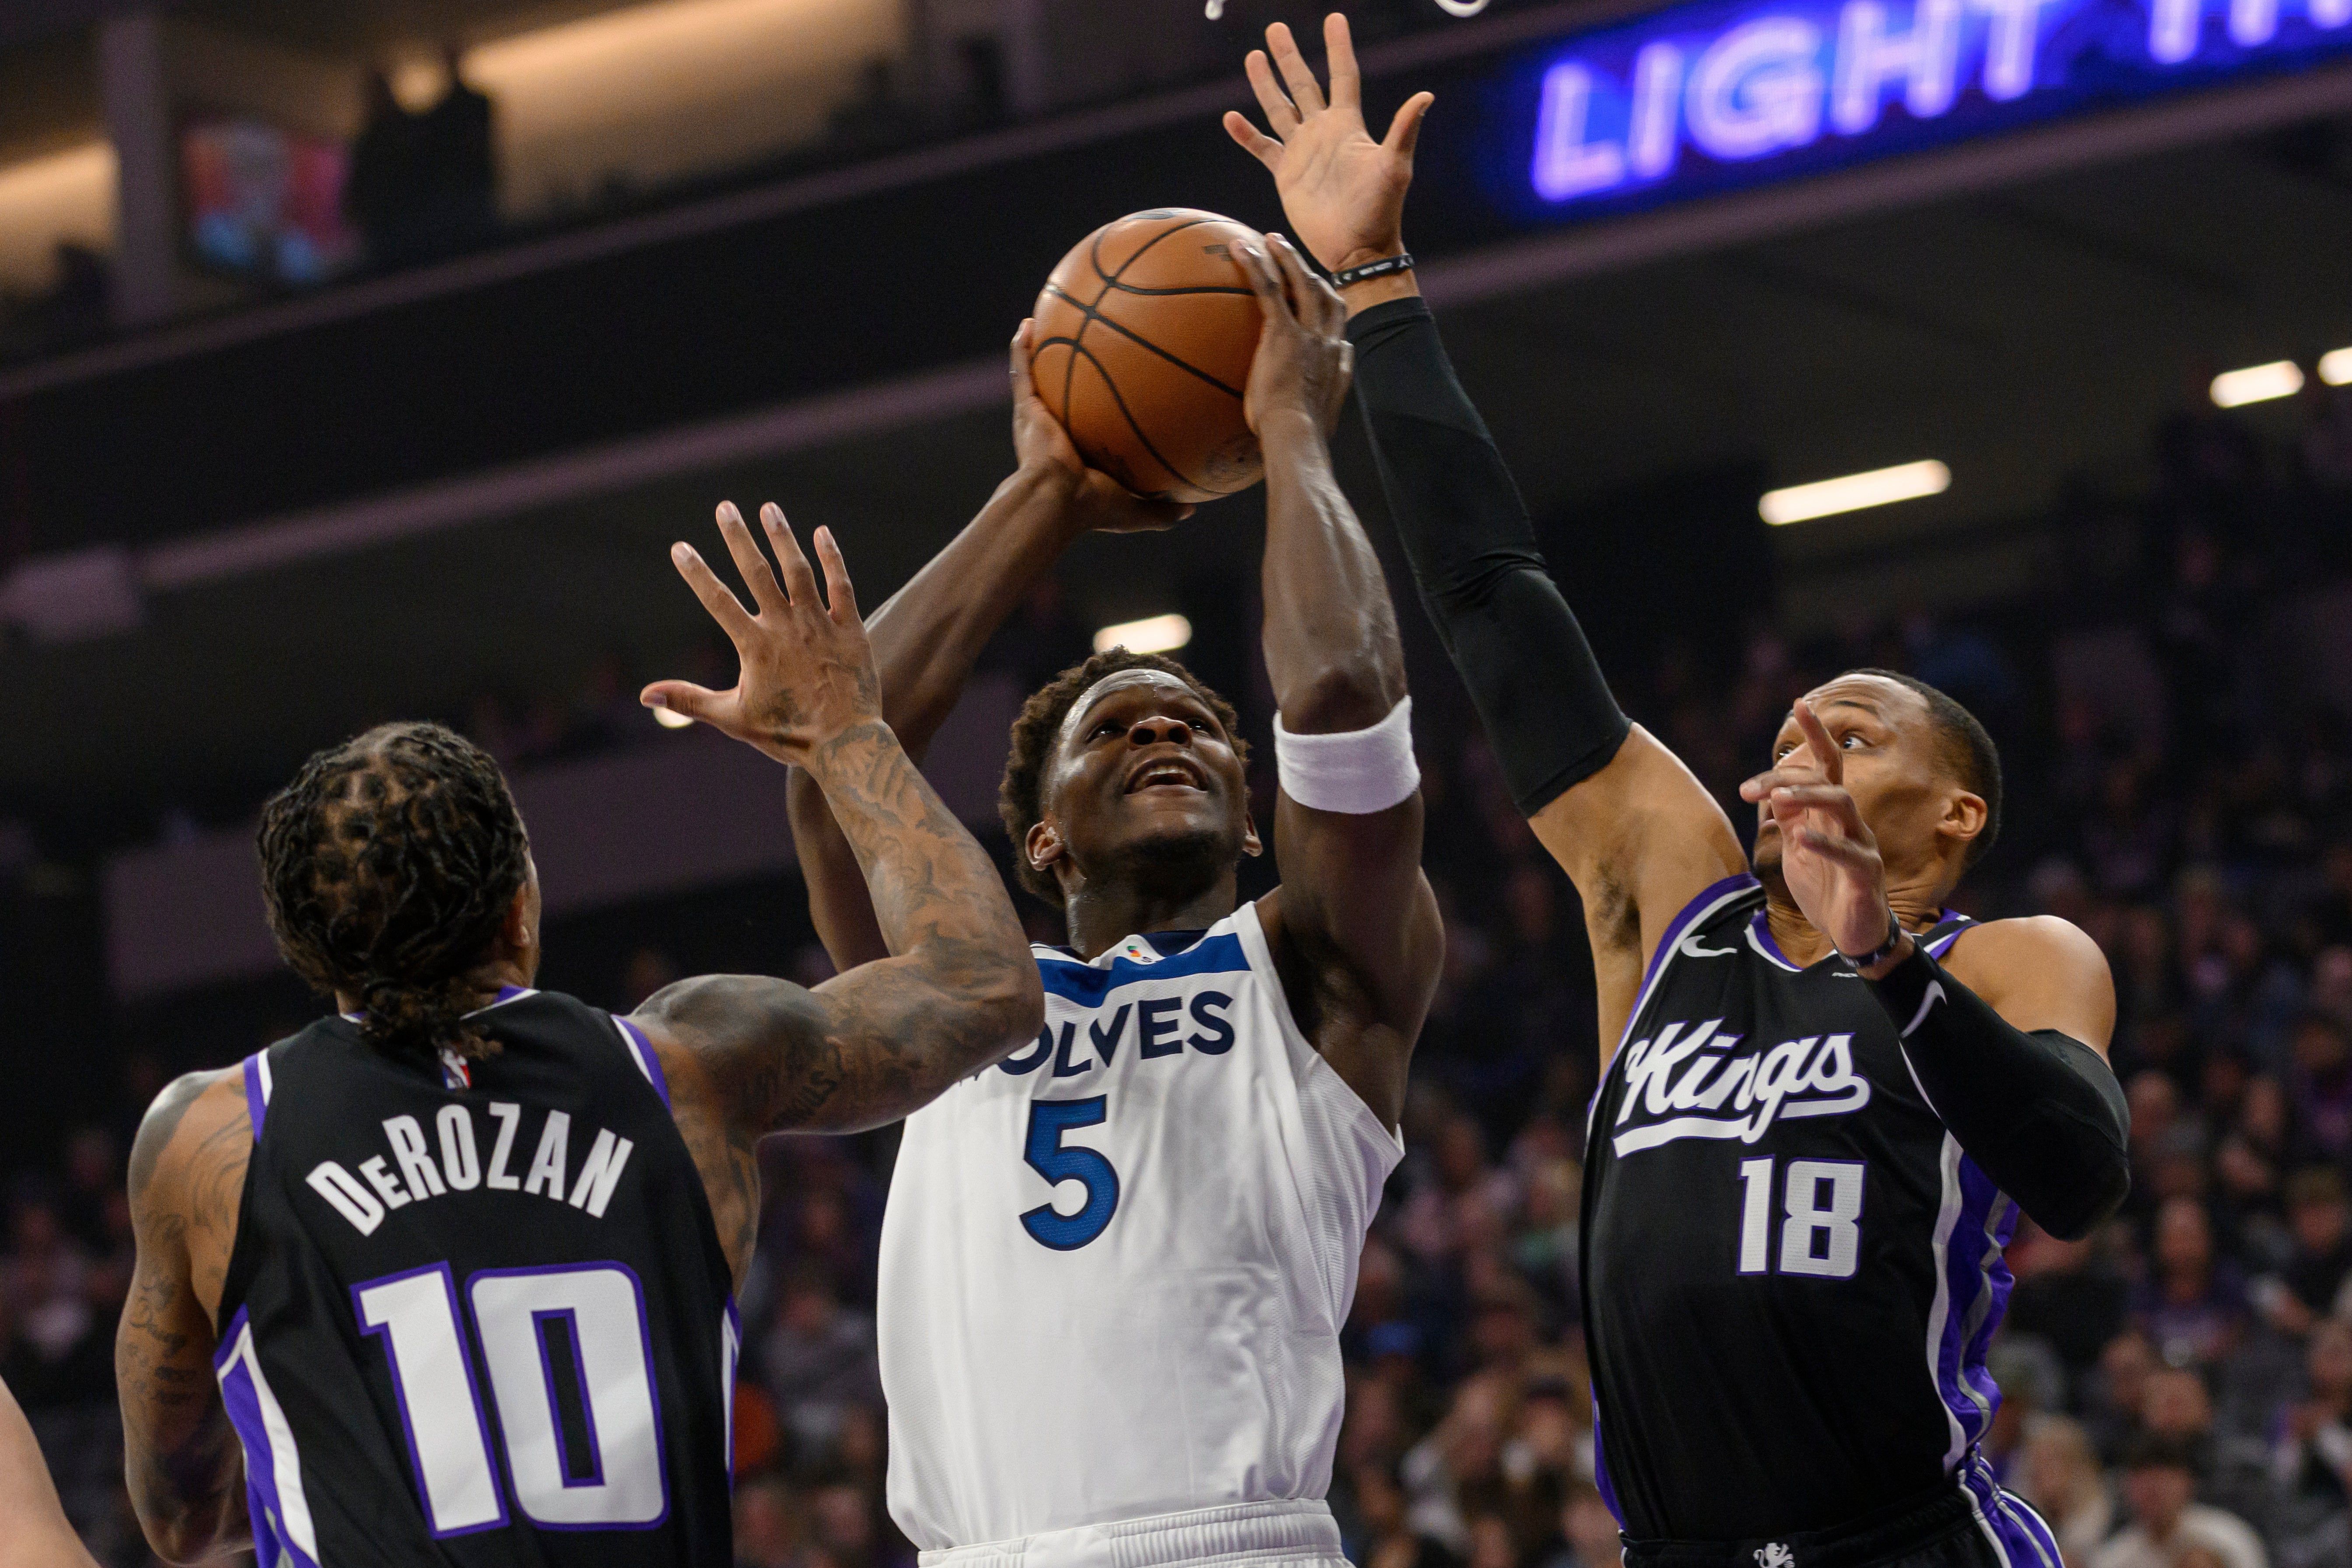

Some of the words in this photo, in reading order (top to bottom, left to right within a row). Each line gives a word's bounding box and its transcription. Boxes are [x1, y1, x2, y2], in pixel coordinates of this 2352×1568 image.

[1533, 0, 2054, 201] LIGHT
[959, 991, 1236, 1087] OLVES
[1613, 1017, 1871, 1158] Kings
[306, 1102, 633, 1237] DeROZAN
[1019, 1093, 1120, 1251] 5
[1737, 1154, 1868, 1280] 18
[350, 1260, 670, 1539] 10
